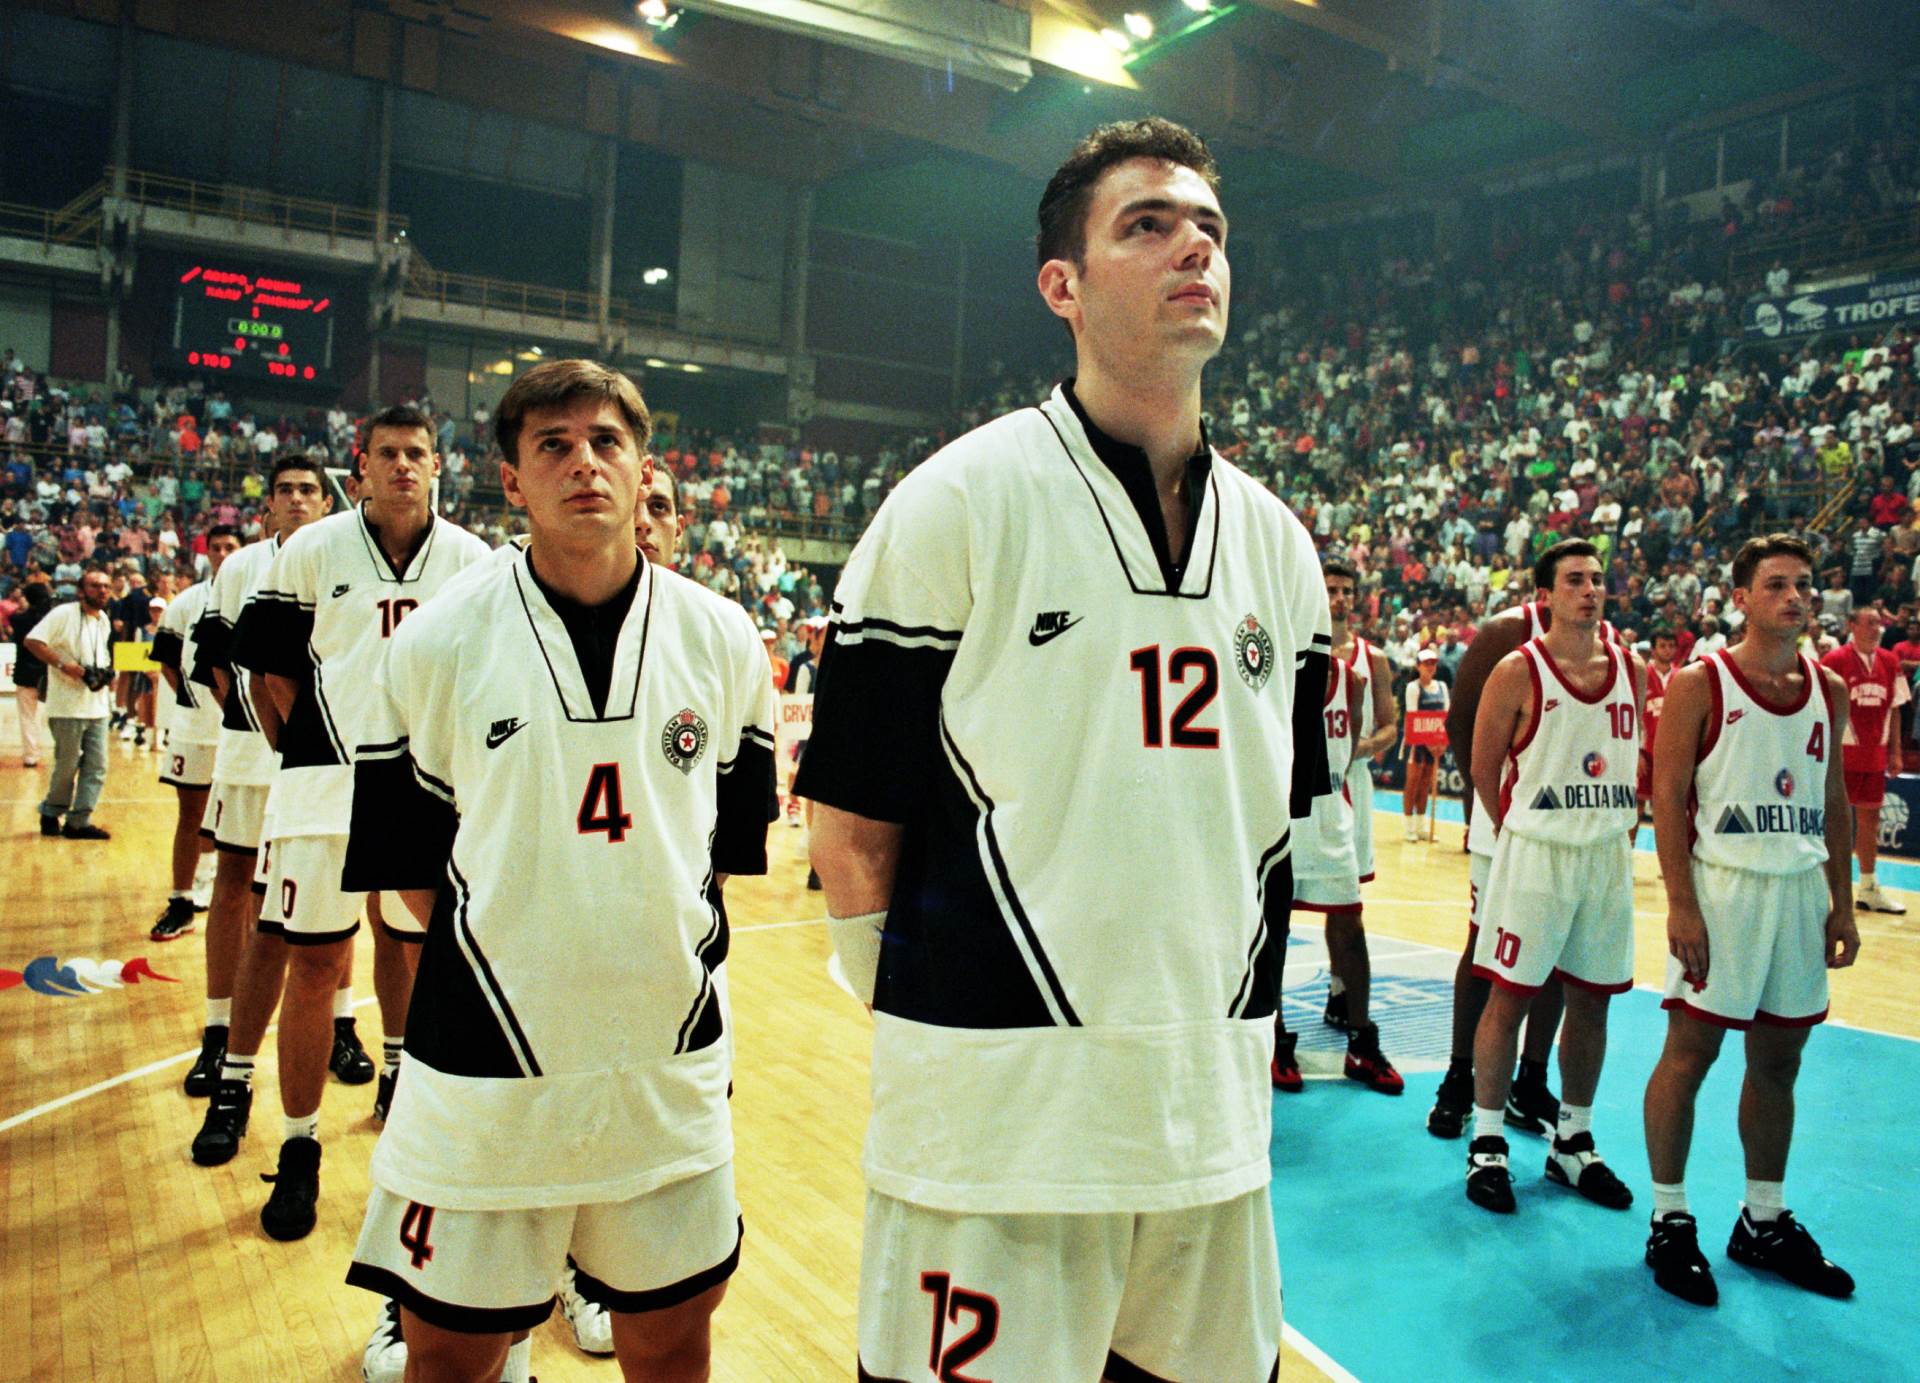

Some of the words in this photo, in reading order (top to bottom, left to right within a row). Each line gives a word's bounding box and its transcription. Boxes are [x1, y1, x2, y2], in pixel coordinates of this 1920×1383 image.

[376, 598, 419, 638] 10
[1034, 610, 1071, 632] NIKE
[1130, 644, 1220, 749] 12
[490, 717, 519, 738] NIKE
[1324, 709, 1348, 739] 13
[1605, 702, 1635, 740] 10
[1806, 721, 1825, 763] 4
[577, 762, 633, 843] 4
[1564, 784, 1610, 809] DELTA
[1494, 926, 1523, 969] 10
[399, 1199, 436, 1272] 4
[920, 1271, 1001, 1383] 12
